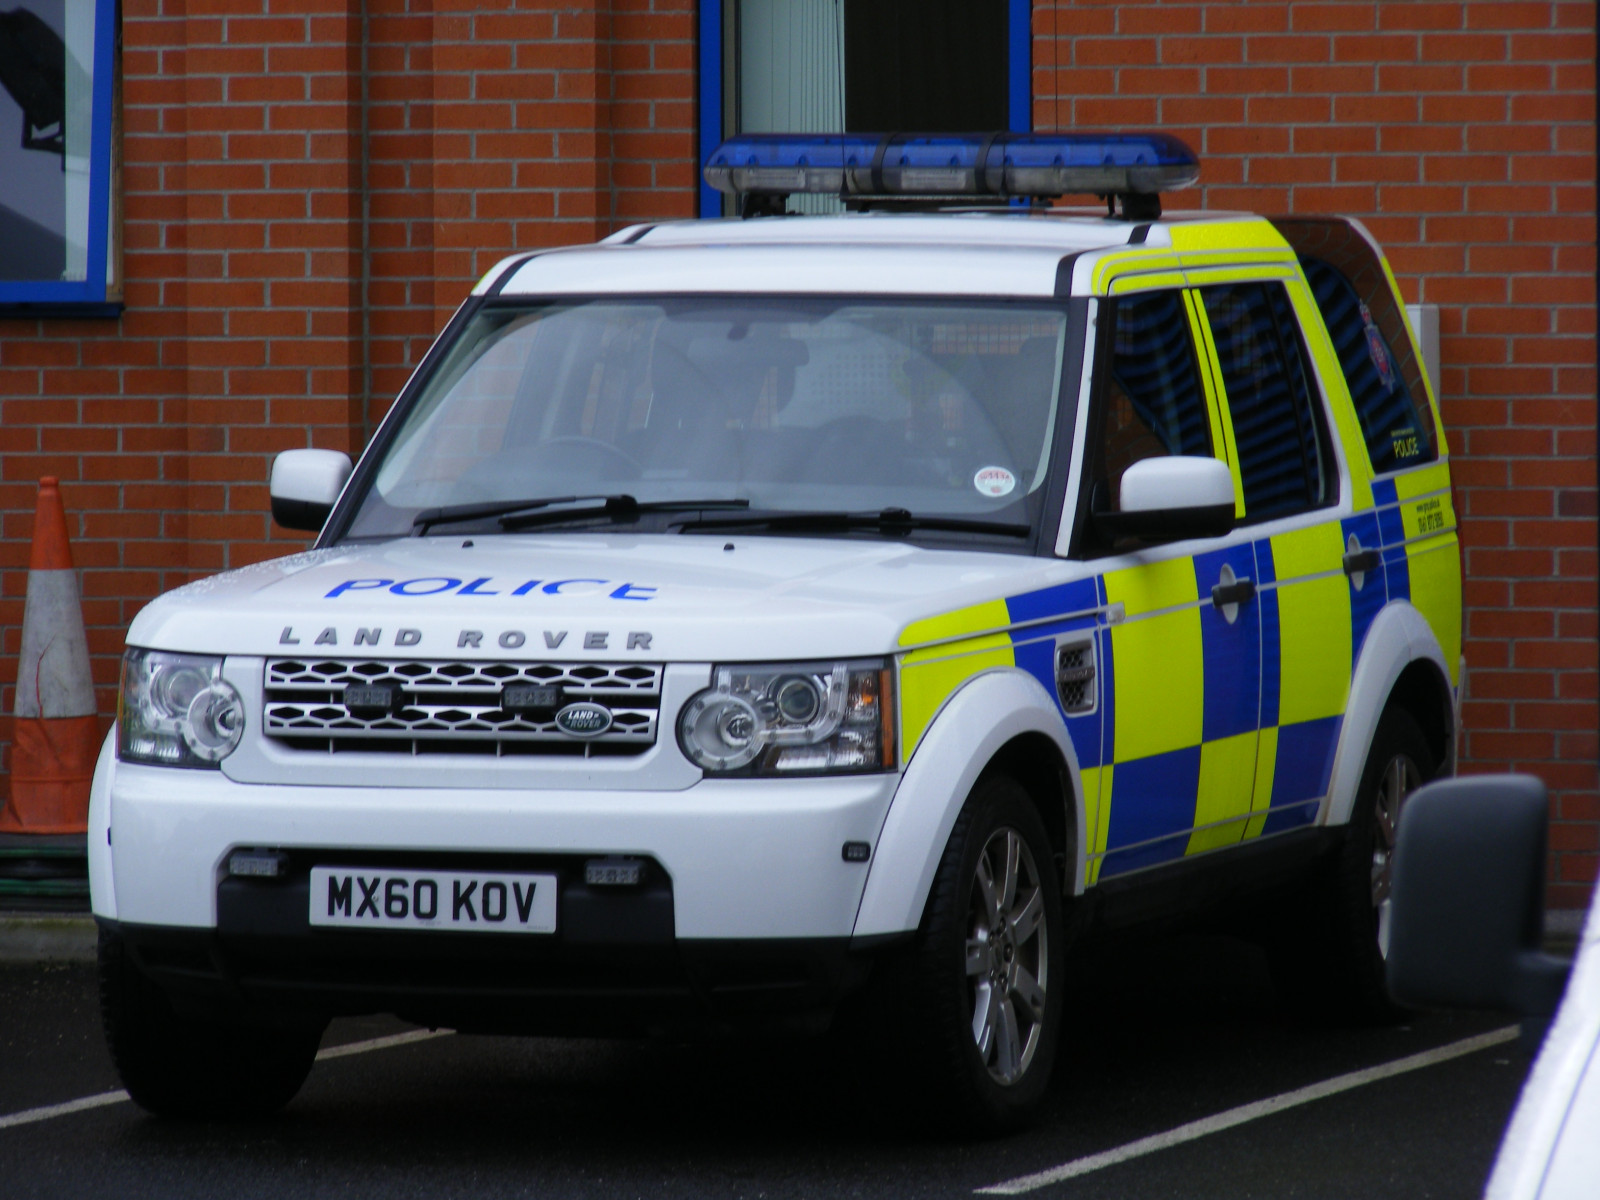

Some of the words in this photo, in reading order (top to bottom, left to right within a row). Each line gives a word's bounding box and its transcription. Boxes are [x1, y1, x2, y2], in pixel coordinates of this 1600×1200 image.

[1393, 437, 1419, 458] POLICE
[324, 577, 658, 600] POLICE
[279, 626, 422, 648] LAND
[457, 630, 653, 650] ROVER
[568, 710, 594, 720] LAND
[570, 719, 601, 728] ROVER
[328, 876, 438, 919] MX60
[452, 880, 537, 923] KOV
